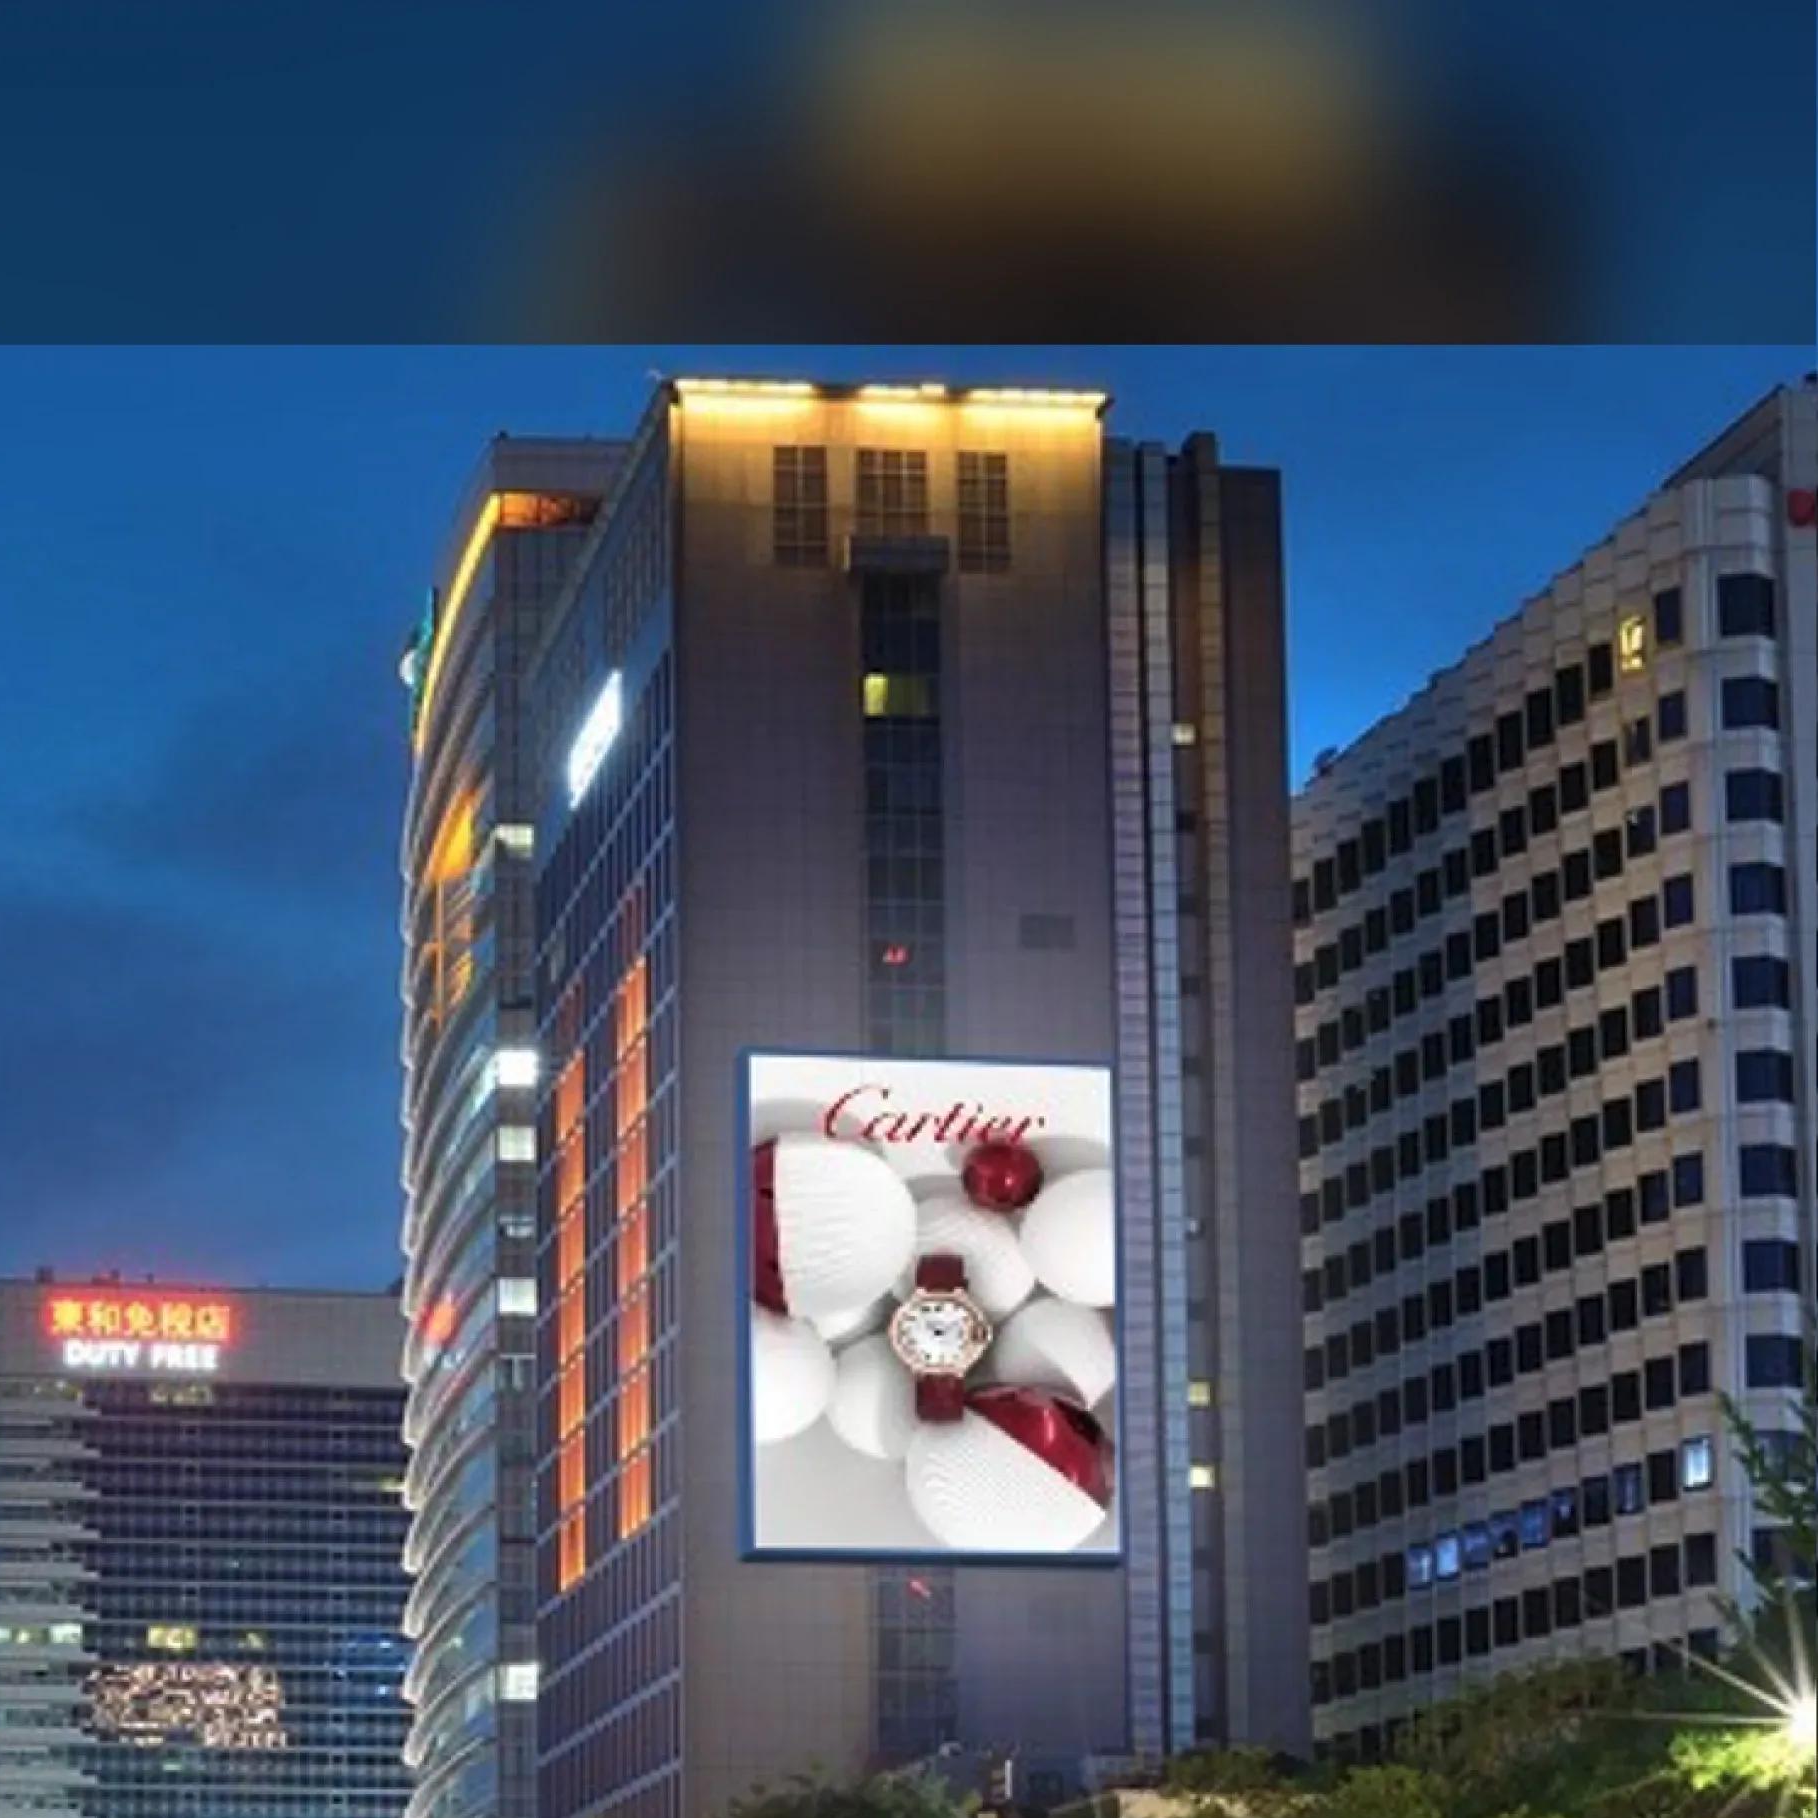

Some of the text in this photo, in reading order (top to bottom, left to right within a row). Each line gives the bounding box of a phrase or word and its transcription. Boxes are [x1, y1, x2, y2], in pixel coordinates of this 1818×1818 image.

[823, 1084, 1046, 1142] Cartier
[64, 1338, 220, 1369] DUTY FREE
